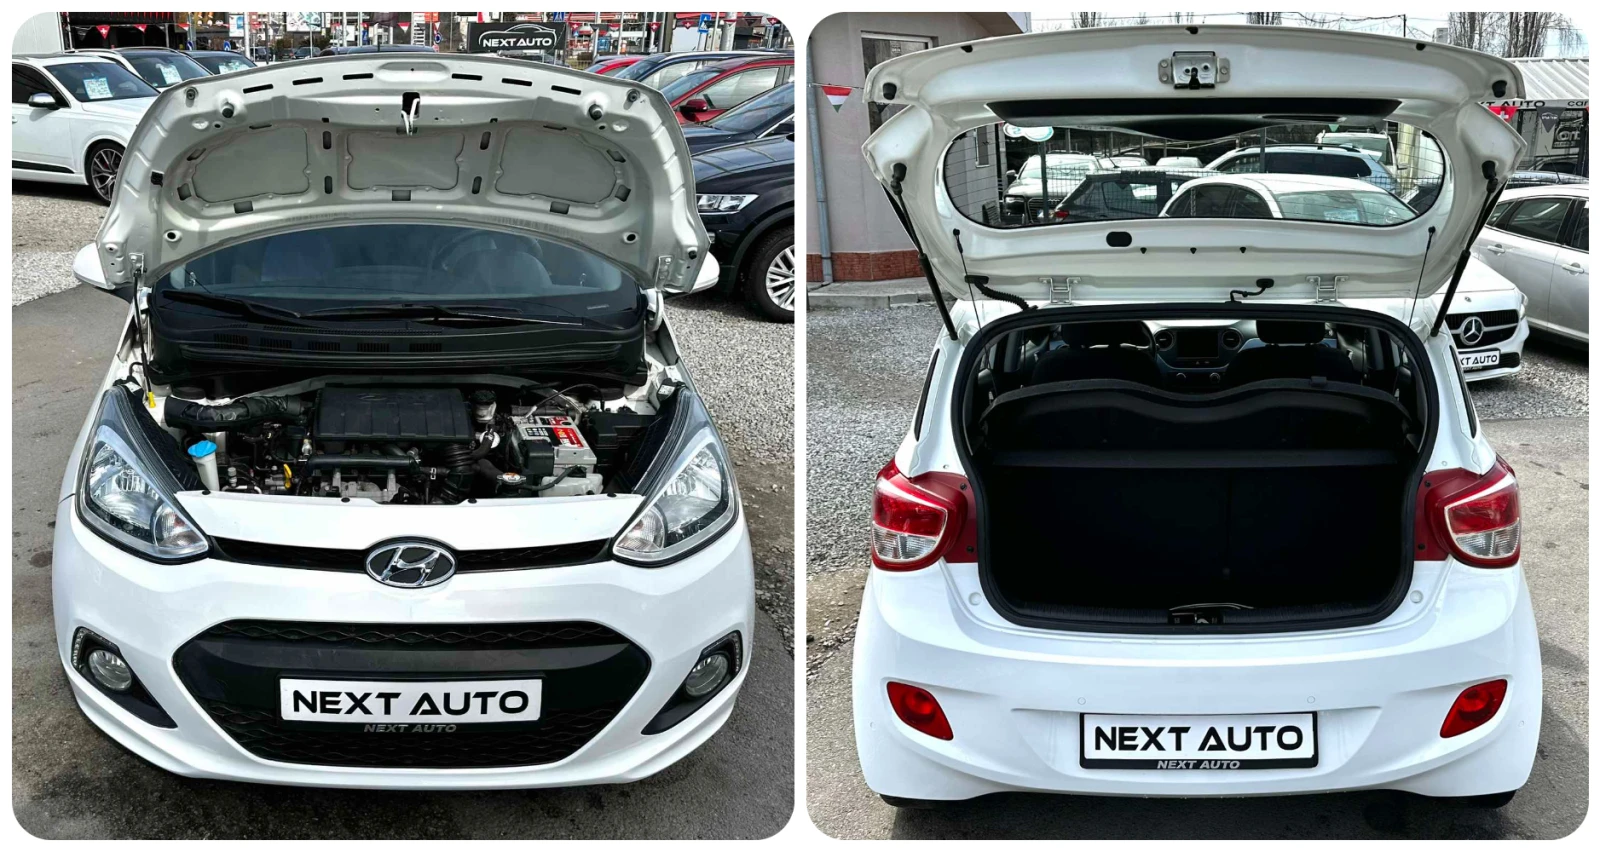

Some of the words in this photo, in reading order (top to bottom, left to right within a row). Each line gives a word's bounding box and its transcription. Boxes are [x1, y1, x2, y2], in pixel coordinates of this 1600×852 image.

[482, 38, 515, 48] NEXT
[517, 37, 553, 47] AUTO
[1472, 354, 1498, 364] AUTO
[293, 690, 401, 716] NEXT
[408, 690, 529, 716] AUTO
[363, 723, 409, 733] NEXT
[413, 723, 457, 733] AUTO
[1094, 726, 1191, 751] NEXT
[1197, 725, 1304, 751] AUTO
[1157, 760, 1197, 770] NEXT
[1200, 760, 1241, 770] AUTO
